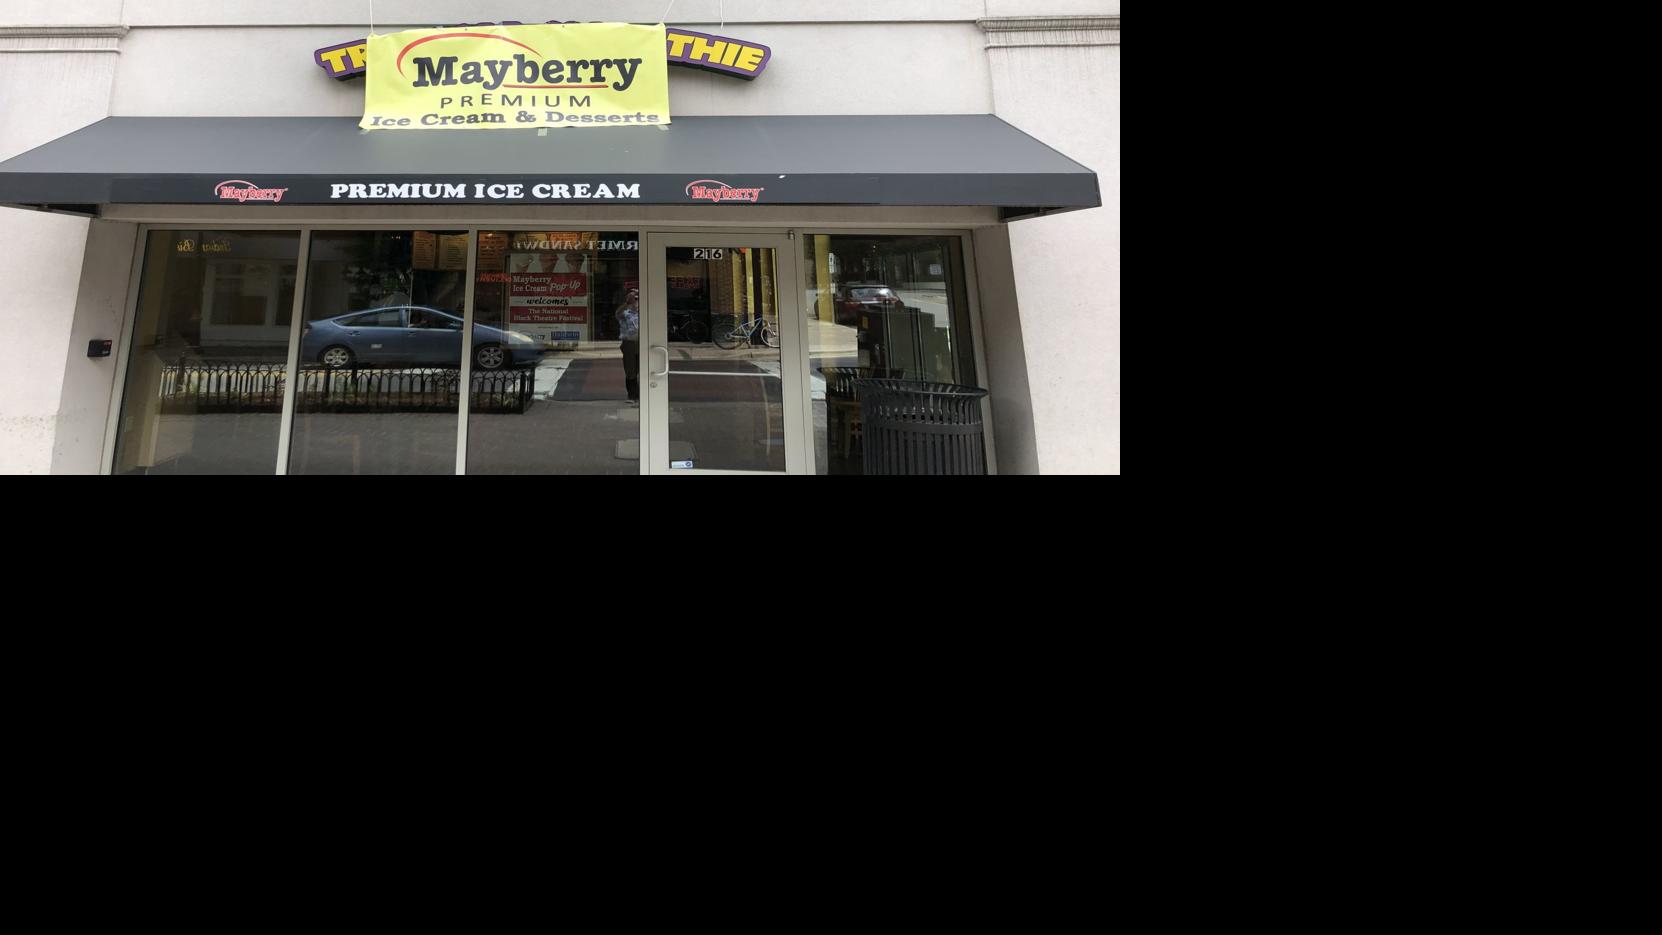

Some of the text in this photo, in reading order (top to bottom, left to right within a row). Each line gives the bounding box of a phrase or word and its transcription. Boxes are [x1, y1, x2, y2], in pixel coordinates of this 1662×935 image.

[667, 33, 764, 72] THIE
[412, 54, 642, 91] Mayberry
[440, 93, 591, 109] PREMIUM
[370, 110, 660, 126] Ice Cream & Desserts
[220, 186, 285, 203] Mayberry
[330, 183, 641, 199] PREMIUM ICE CREAM
[691, 186, 761, 203] Mayberry
[694, 248, 722, 259] 216
[513, 275, 552, 285] Mayberry
[550, 280, 581, 293] Pop-Up
[526, 297, 569, 306] welcomes
